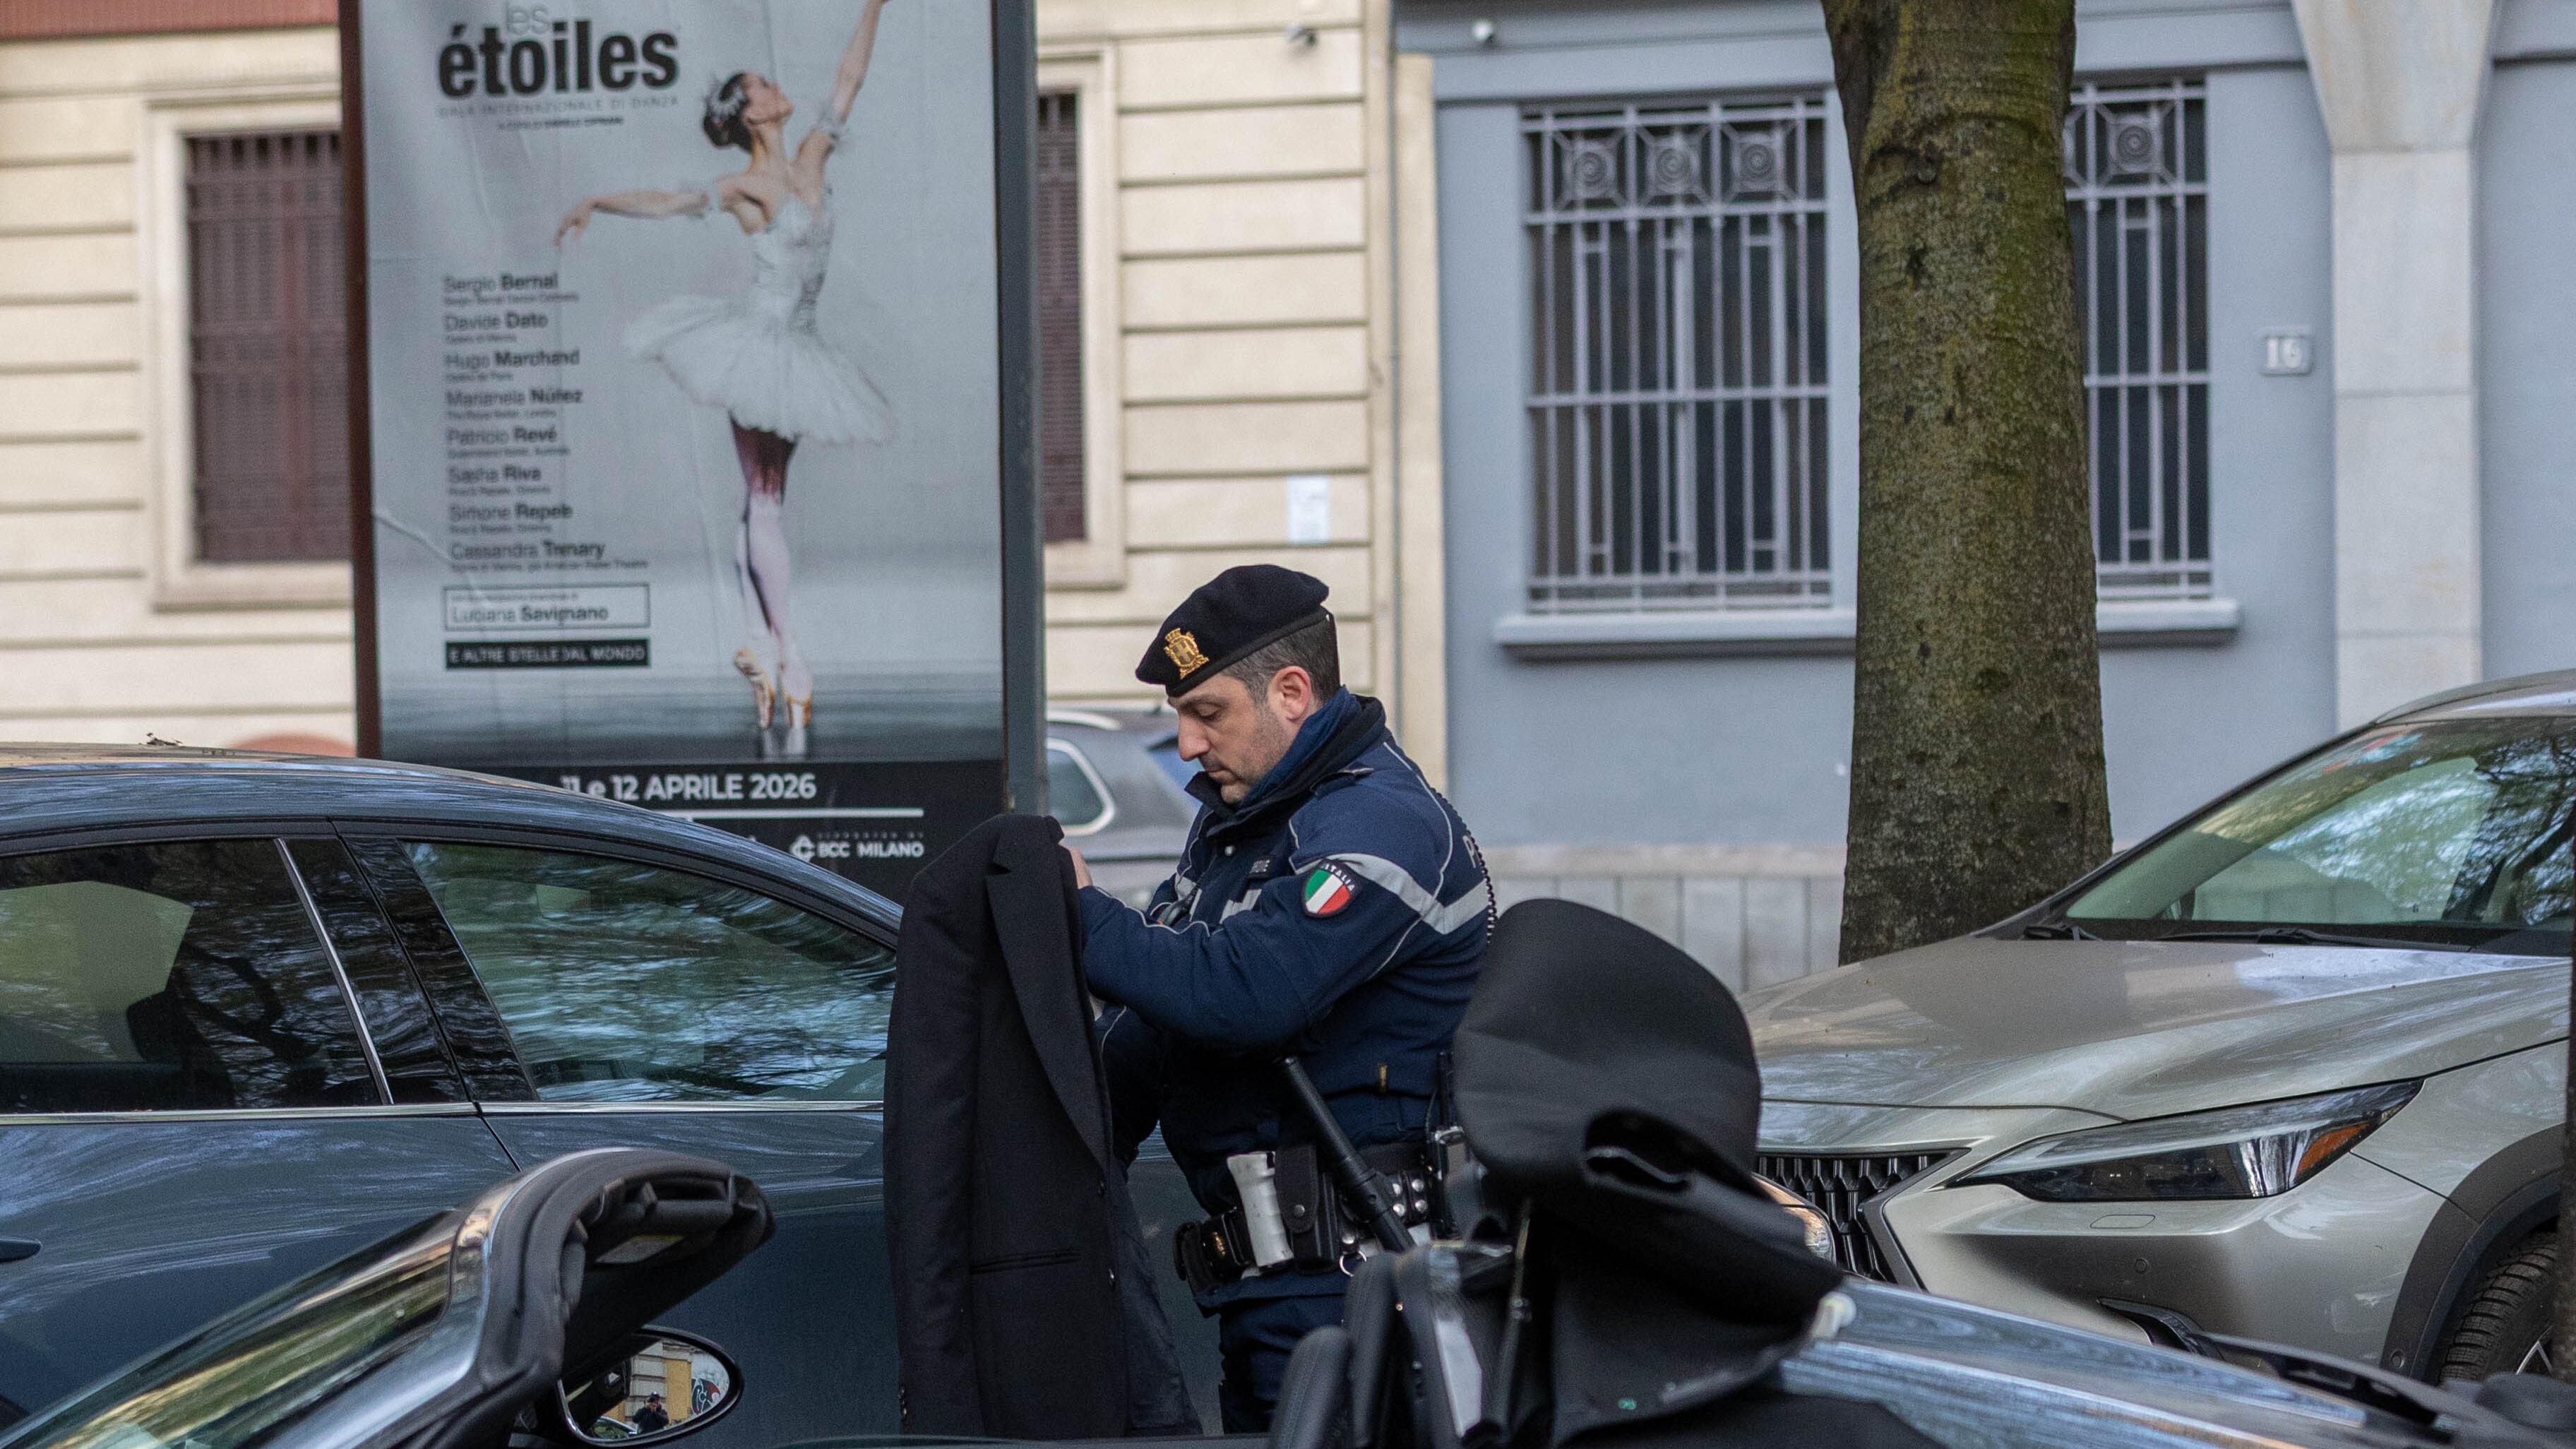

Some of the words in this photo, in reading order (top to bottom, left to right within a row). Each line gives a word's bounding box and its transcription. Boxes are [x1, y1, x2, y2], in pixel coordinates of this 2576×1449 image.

[506, 1, 549, 35] les
[439, 20, 679, 97] étoiles
[445, 275, 496, 295] Sergio
[501, 272, 558, 290] Bernal
[445, 315, 500, 332] Davide
[506, 311, 549, 328] Dato
[445, 354, 490, 371] Hugo
[494, 349, 581, 367] Marchand
[2266, 338, 2303, 369] 16
[446, 391, 526, 406] Marianela
[447, 429, 509, 445] Patricio
[513, 424, 558, 442] Revé
[448, 465, 499, 483] Sasha
[503, 464, 542, 481] Riva
[449, 504, 511, 521] Simone
[451, 543, 539, 560] Cassandra
[453, 607, 516, 624] Luciana
[520, 605, 609, 626] Savignano
[449, 648, 459, 662] E
[461, 648, 506, 662] ALTRE
[508, 647, 559, 662] STELLE
[563, 646, 588, 662] DAL
[590, 645, 646, 661] MONDO
[587, 780, 607, 798] e
[610, 775, 640, 800] 12
[644, 773, 744, 801] APRILE
[749, 773, 817, 800] 2026
[817, 841, 850, 858] BCC
[856, 841, 925, 858] MILANO
[1323, 863, 1356, 893] ITALIA
